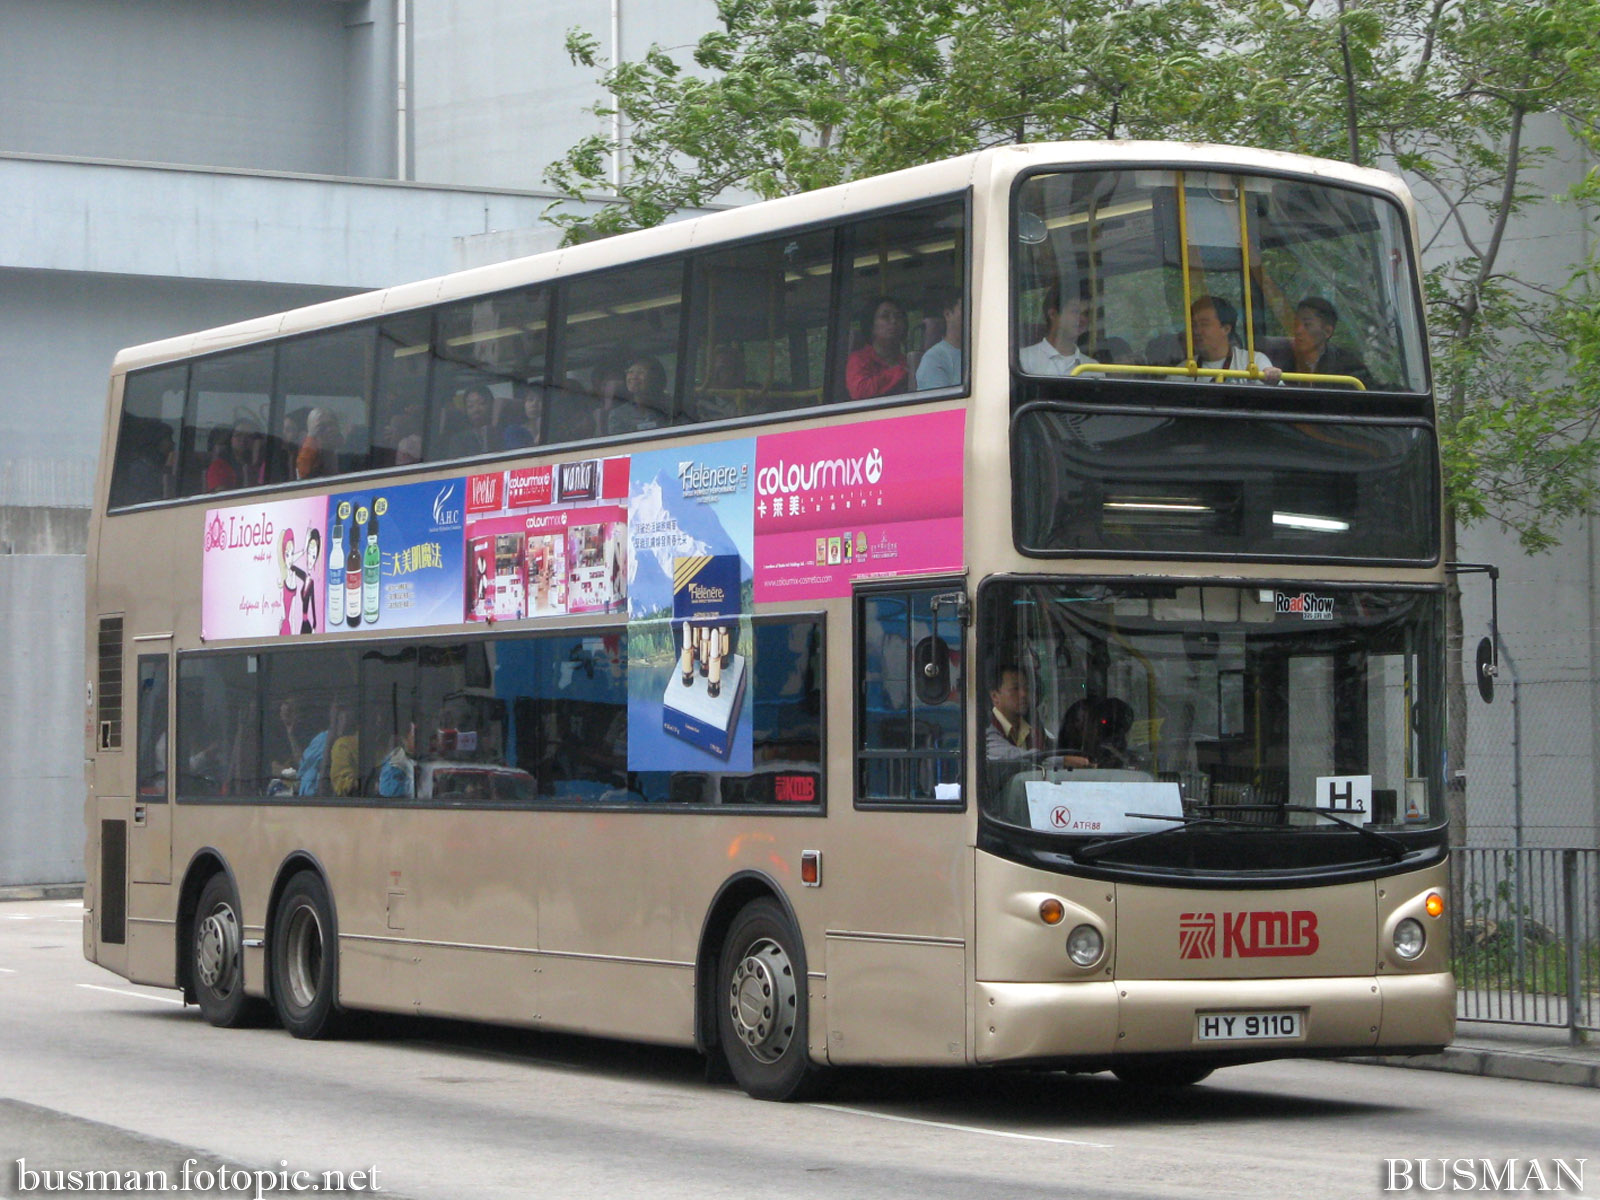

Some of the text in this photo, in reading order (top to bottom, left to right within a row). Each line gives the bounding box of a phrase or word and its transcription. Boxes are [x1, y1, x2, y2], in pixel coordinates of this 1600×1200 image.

[757, 495, 800, 518] 卡萊美
[228, 512, 273, 548] Lioele
[382, 542, 443, 577] 三大美肌魔法
[1276, 593, 1334, 612] RoadShow
[1072, 821, 1101, 831] ATR88
[1204, 1015, 1294, 1037] HY 9110
